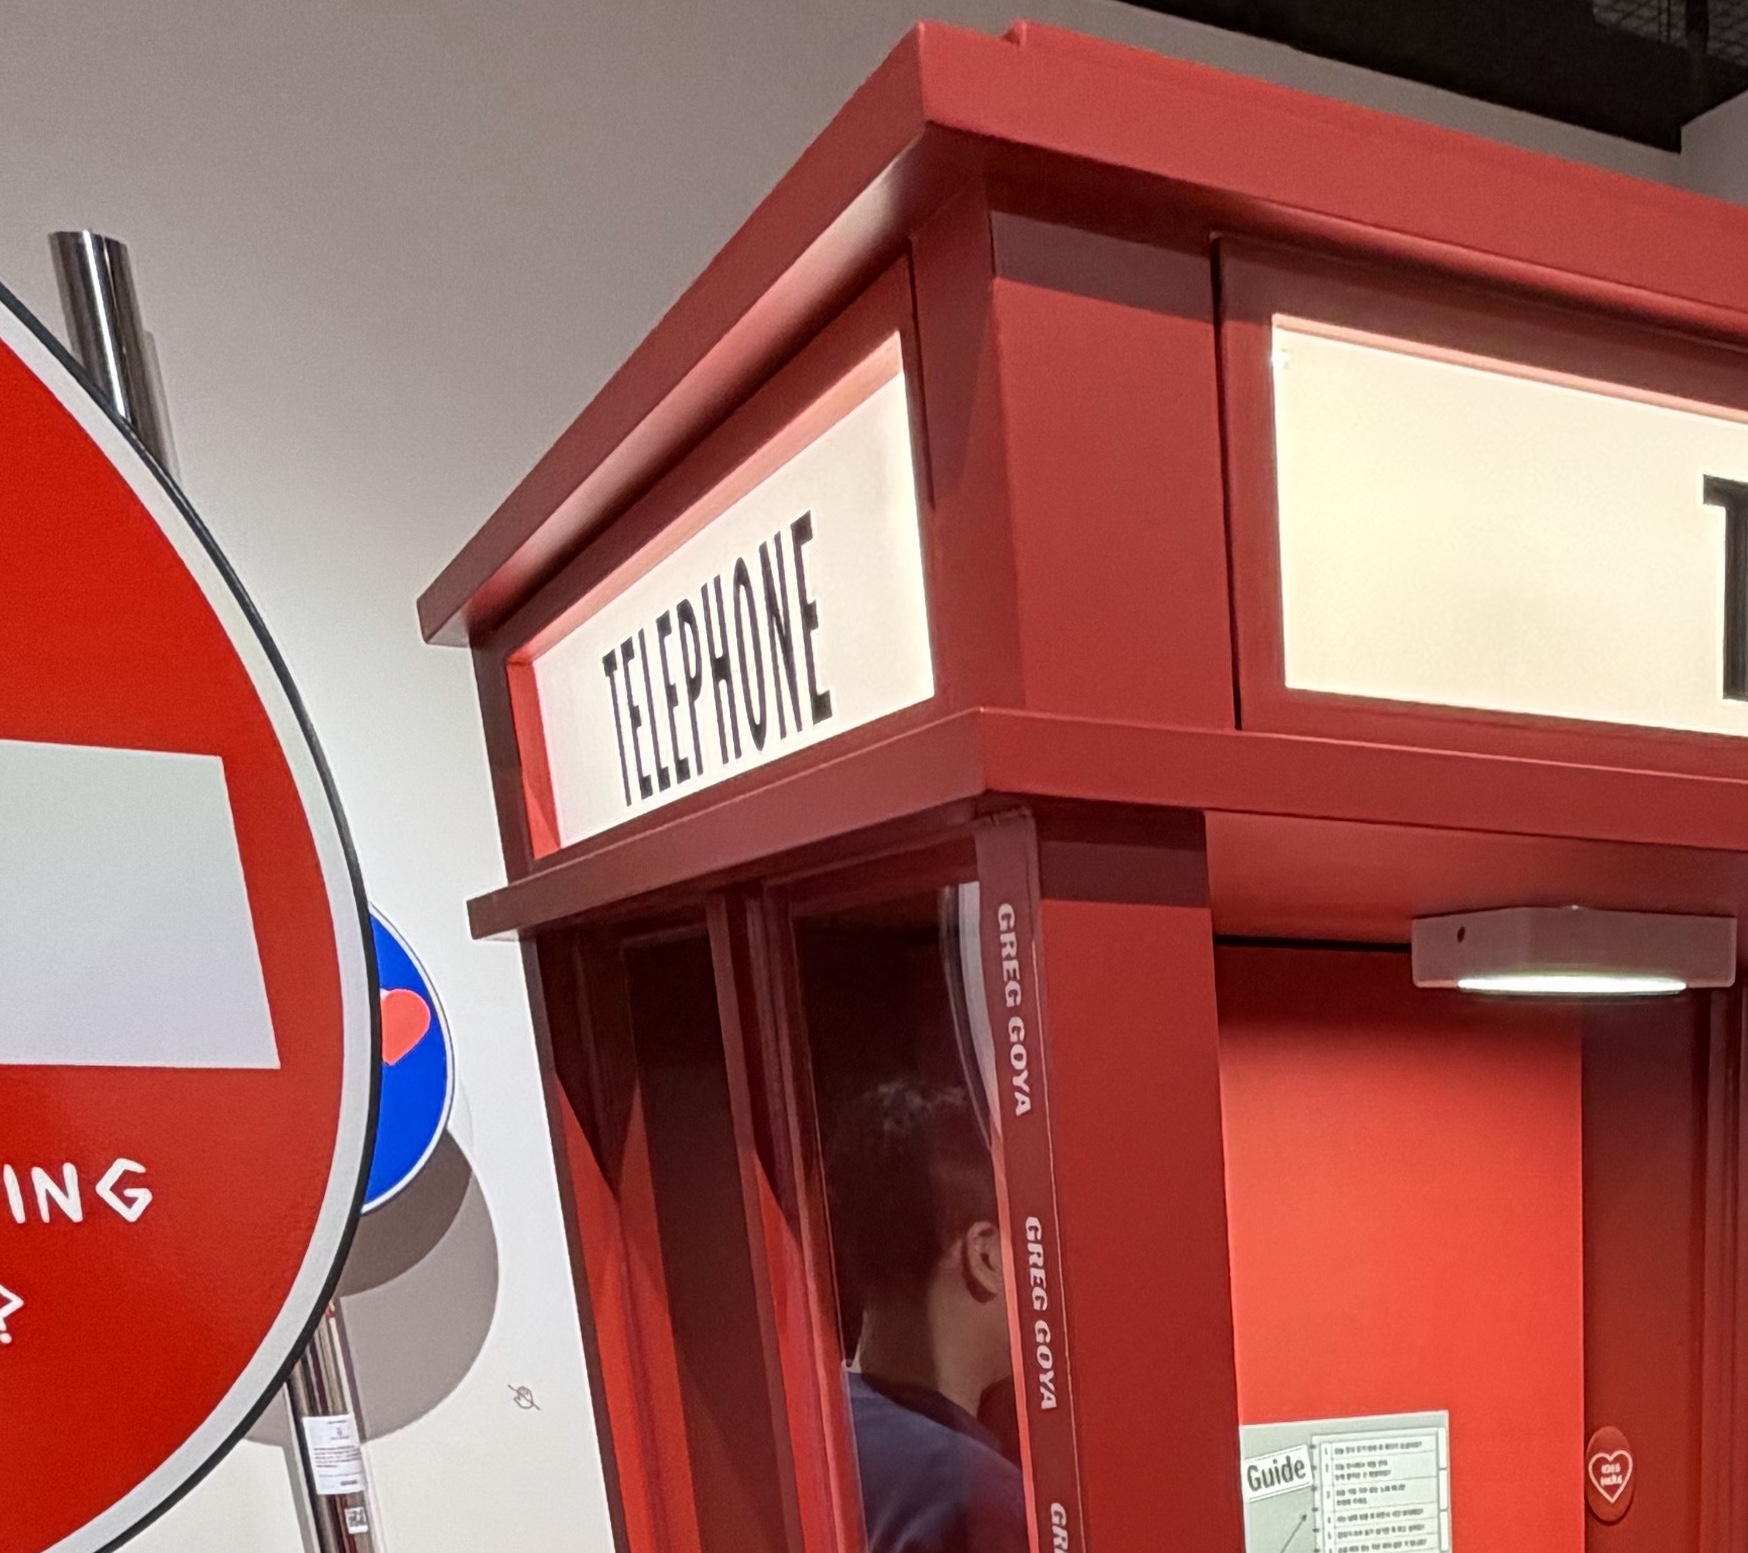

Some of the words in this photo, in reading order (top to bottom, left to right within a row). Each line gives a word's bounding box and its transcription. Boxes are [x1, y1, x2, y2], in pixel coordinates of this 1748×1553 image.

[602, 509, 833, 807] TELEPHONE
[998, 903, 1022, 1008] GREG
[1008, 1016, 1032, 1117] GOYA
[2, 1157, 153, 1225] ING
[1025, 1216, 1048, 1312] GREG
[1034, 1319, 1058, 1411] GOYA
[1247, 1455, 1307, 1492] Guide
